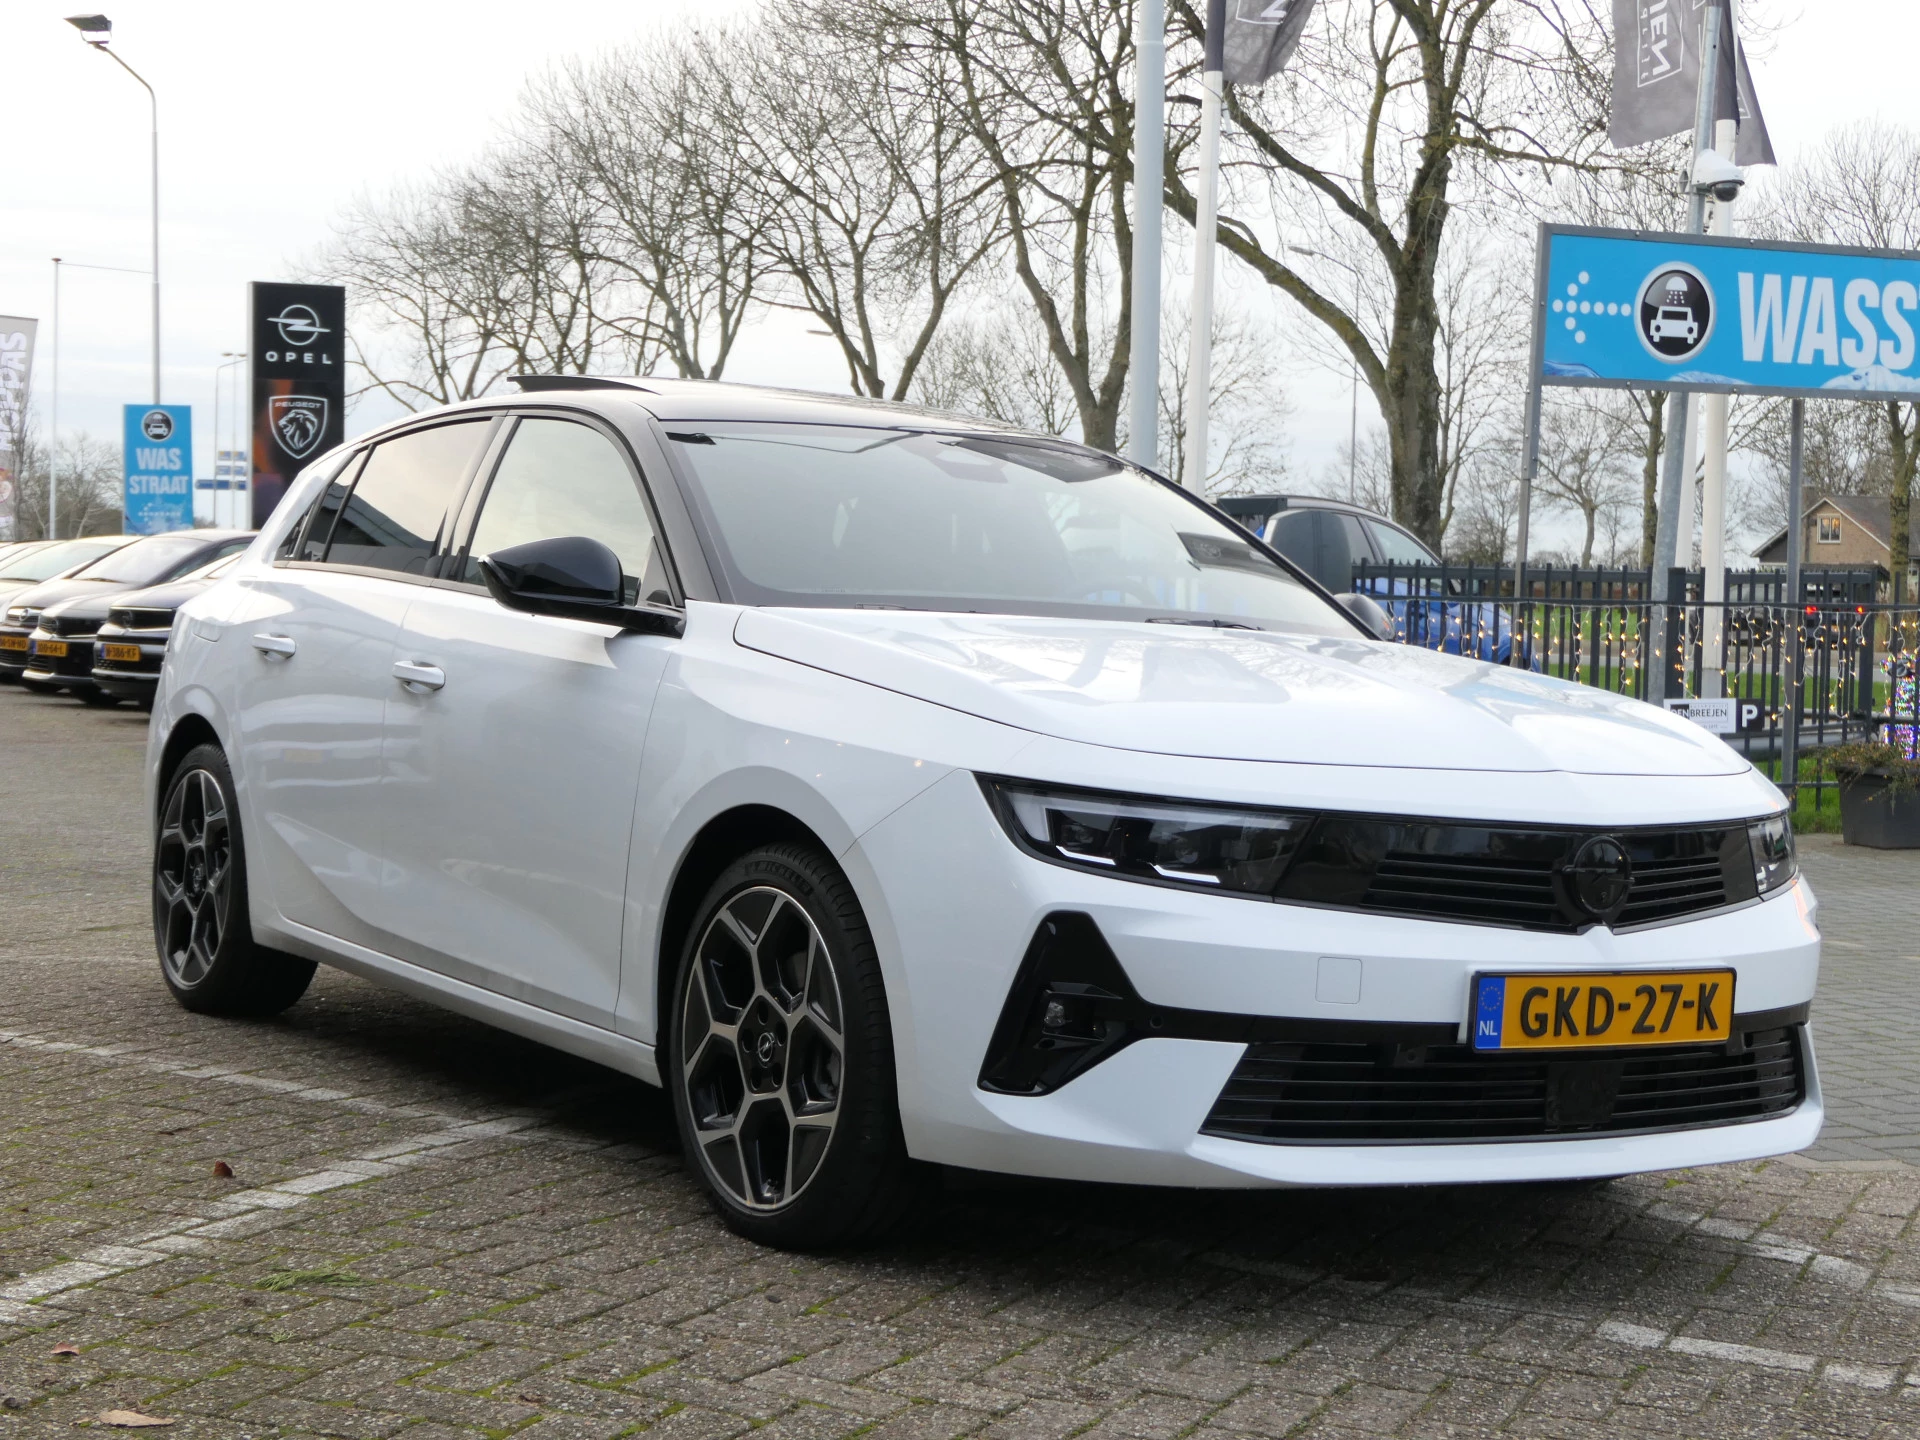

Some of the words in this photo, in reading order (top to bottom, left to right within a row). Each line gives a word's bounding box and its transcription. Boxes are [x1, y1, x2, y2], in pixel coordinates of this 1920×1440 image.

[266, 351, 332, 365] OPEL
[274, 401, 321, 409] PEUGEOT
[136, 447, 182, 470] WAS
[129, 475, 189, 495] STRAAT
[1690, 709, 1727, 717] BREEJEN
[1741, 704, 1758, 728] P
[1520, 982, 1719, 1038] GKD-27-K
[1479, 1020, 1498, 1036] NL
